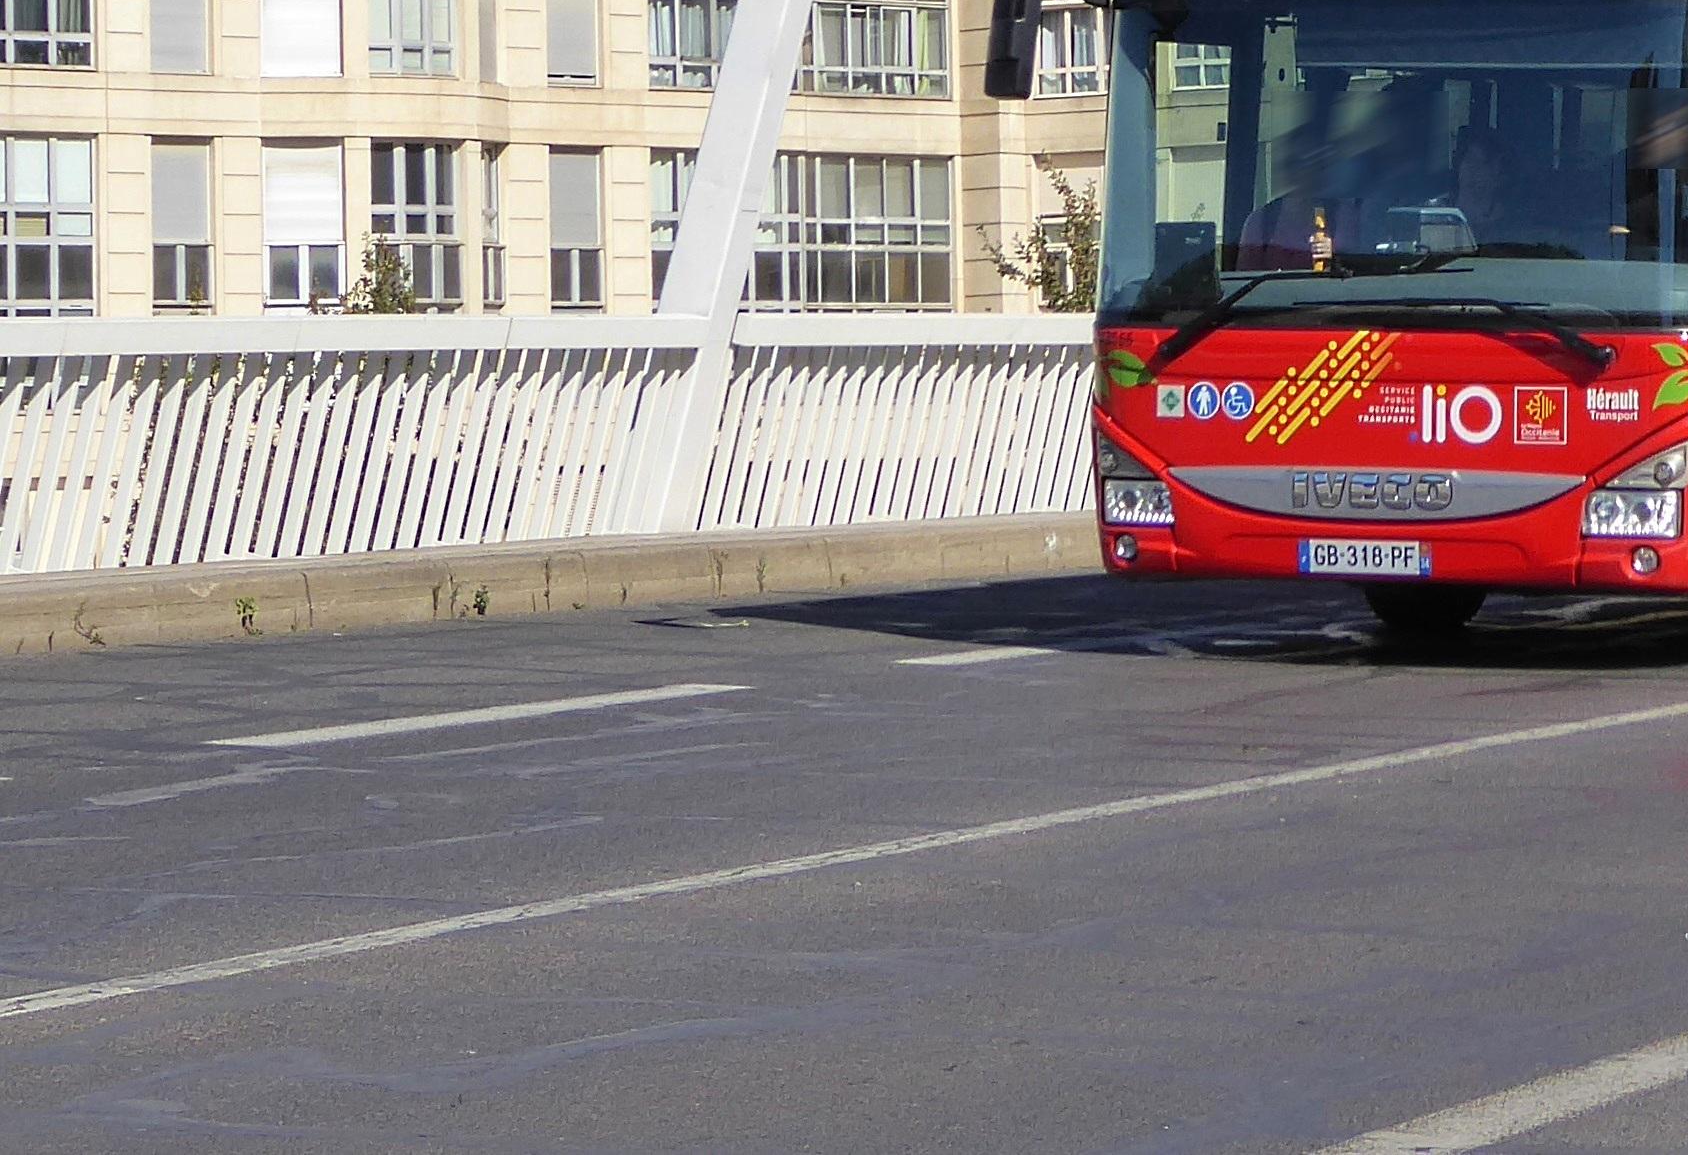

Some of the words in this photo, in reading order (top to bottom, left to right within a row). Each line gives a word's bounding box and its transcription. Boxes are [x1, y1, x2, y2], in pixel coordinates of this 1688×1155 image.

[1379, 385, 1415, 395] SERVICE
[1384, 396, 1415, 405] PUBLIC
[1586, 387, 1639, 411] Hérault
[1368, 405, 1415, 414] OCCITANIE
[1357, 414, 1416, 424] TRANSPORTS
[1589, 409, 1638, 423] Transport
[1292, 471, 1453, 512] IVECO
[1313, 544, 1417, 569] GB-318-PF
